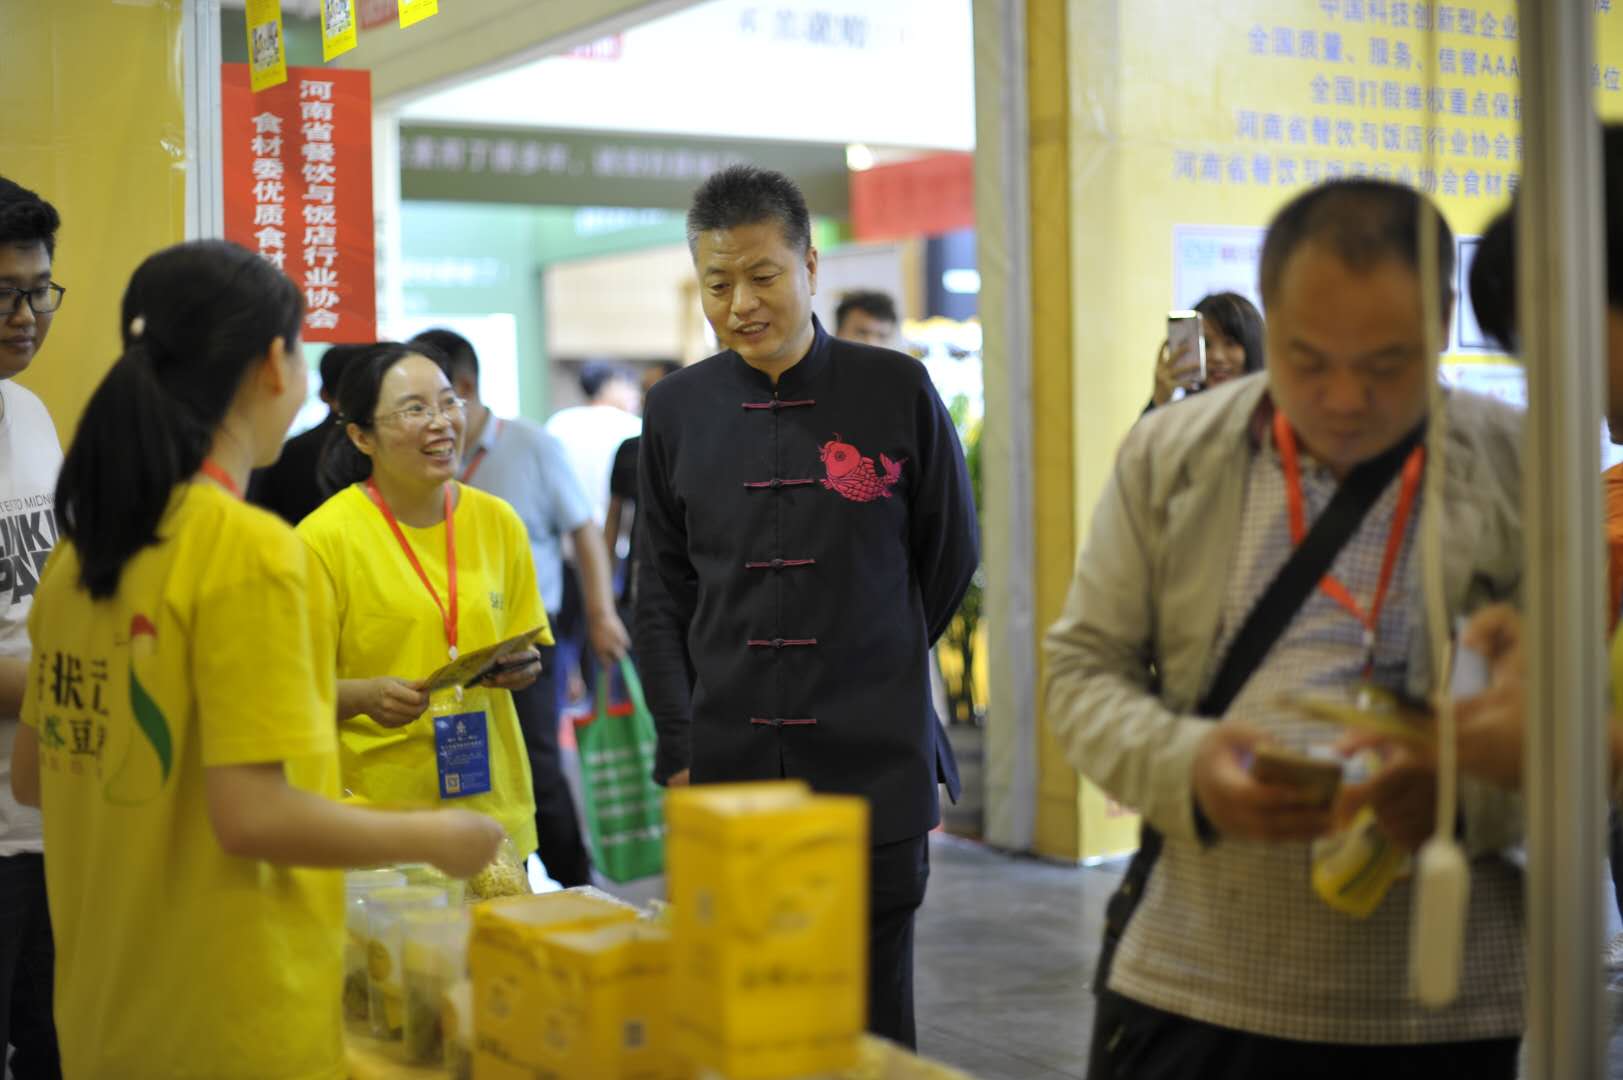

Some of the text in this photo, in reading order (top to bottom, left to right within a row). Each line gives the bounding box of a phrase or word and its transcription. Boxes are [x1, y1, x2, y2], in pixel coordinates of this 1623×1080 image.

[300, 79, 340, 330] 河南省餐饮与饭店行业协会
